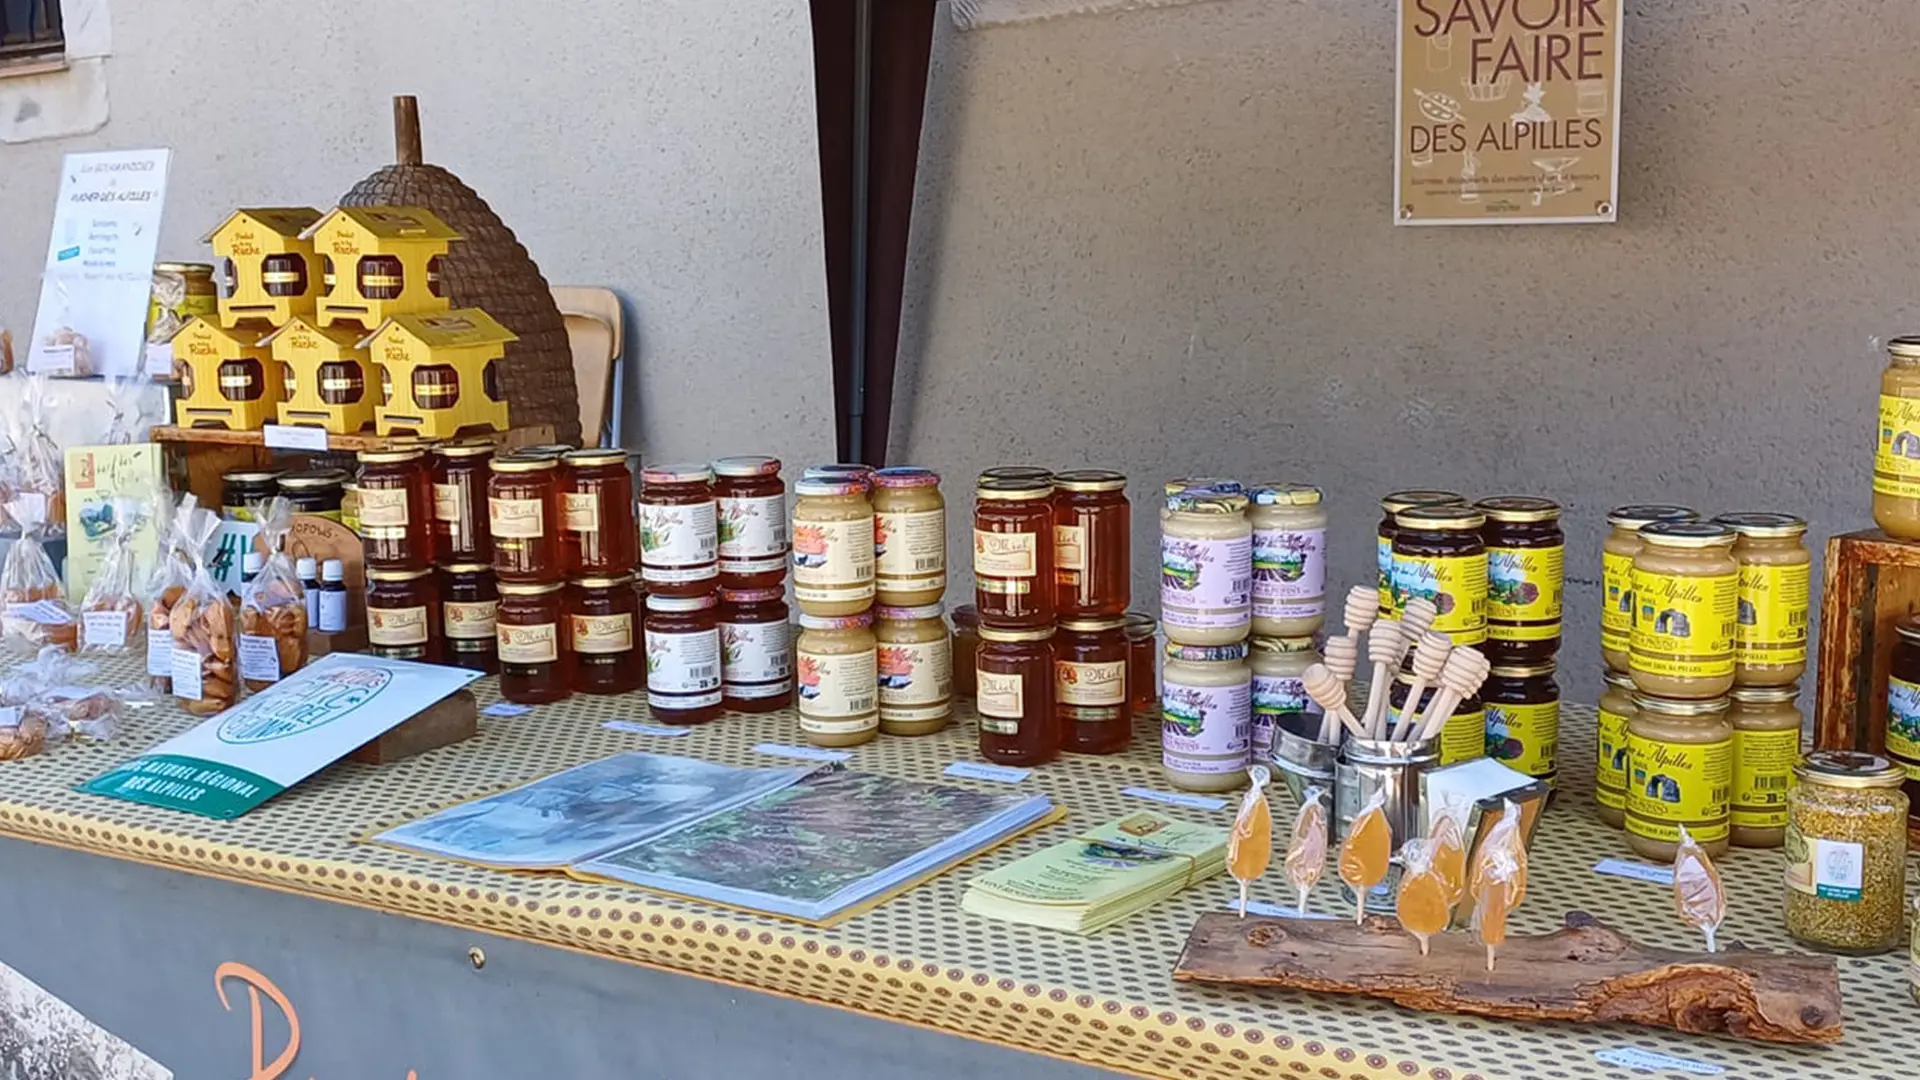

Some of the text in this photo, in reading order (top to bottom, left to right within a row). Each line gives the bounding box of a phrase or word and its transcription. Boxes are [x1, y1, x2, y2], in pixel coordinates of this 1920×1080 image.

[1414, 0, 1606, 37] SAVOIR
[1471, 31, 1604, 85] FAIRE
[1410, 118, 1602, 154] DES ALPILLES
[1409, 560, 1453, 584] Alpilles
[1496, 552, 1538, 574] Alpilles
[1655, 577, 1703, 604] Alpilles
[1647, 742, 1694, 770] Alpilles
[147, 778, 206, 801] ALPILLES
[194, 768, 261, 799] RÉGIONAL
